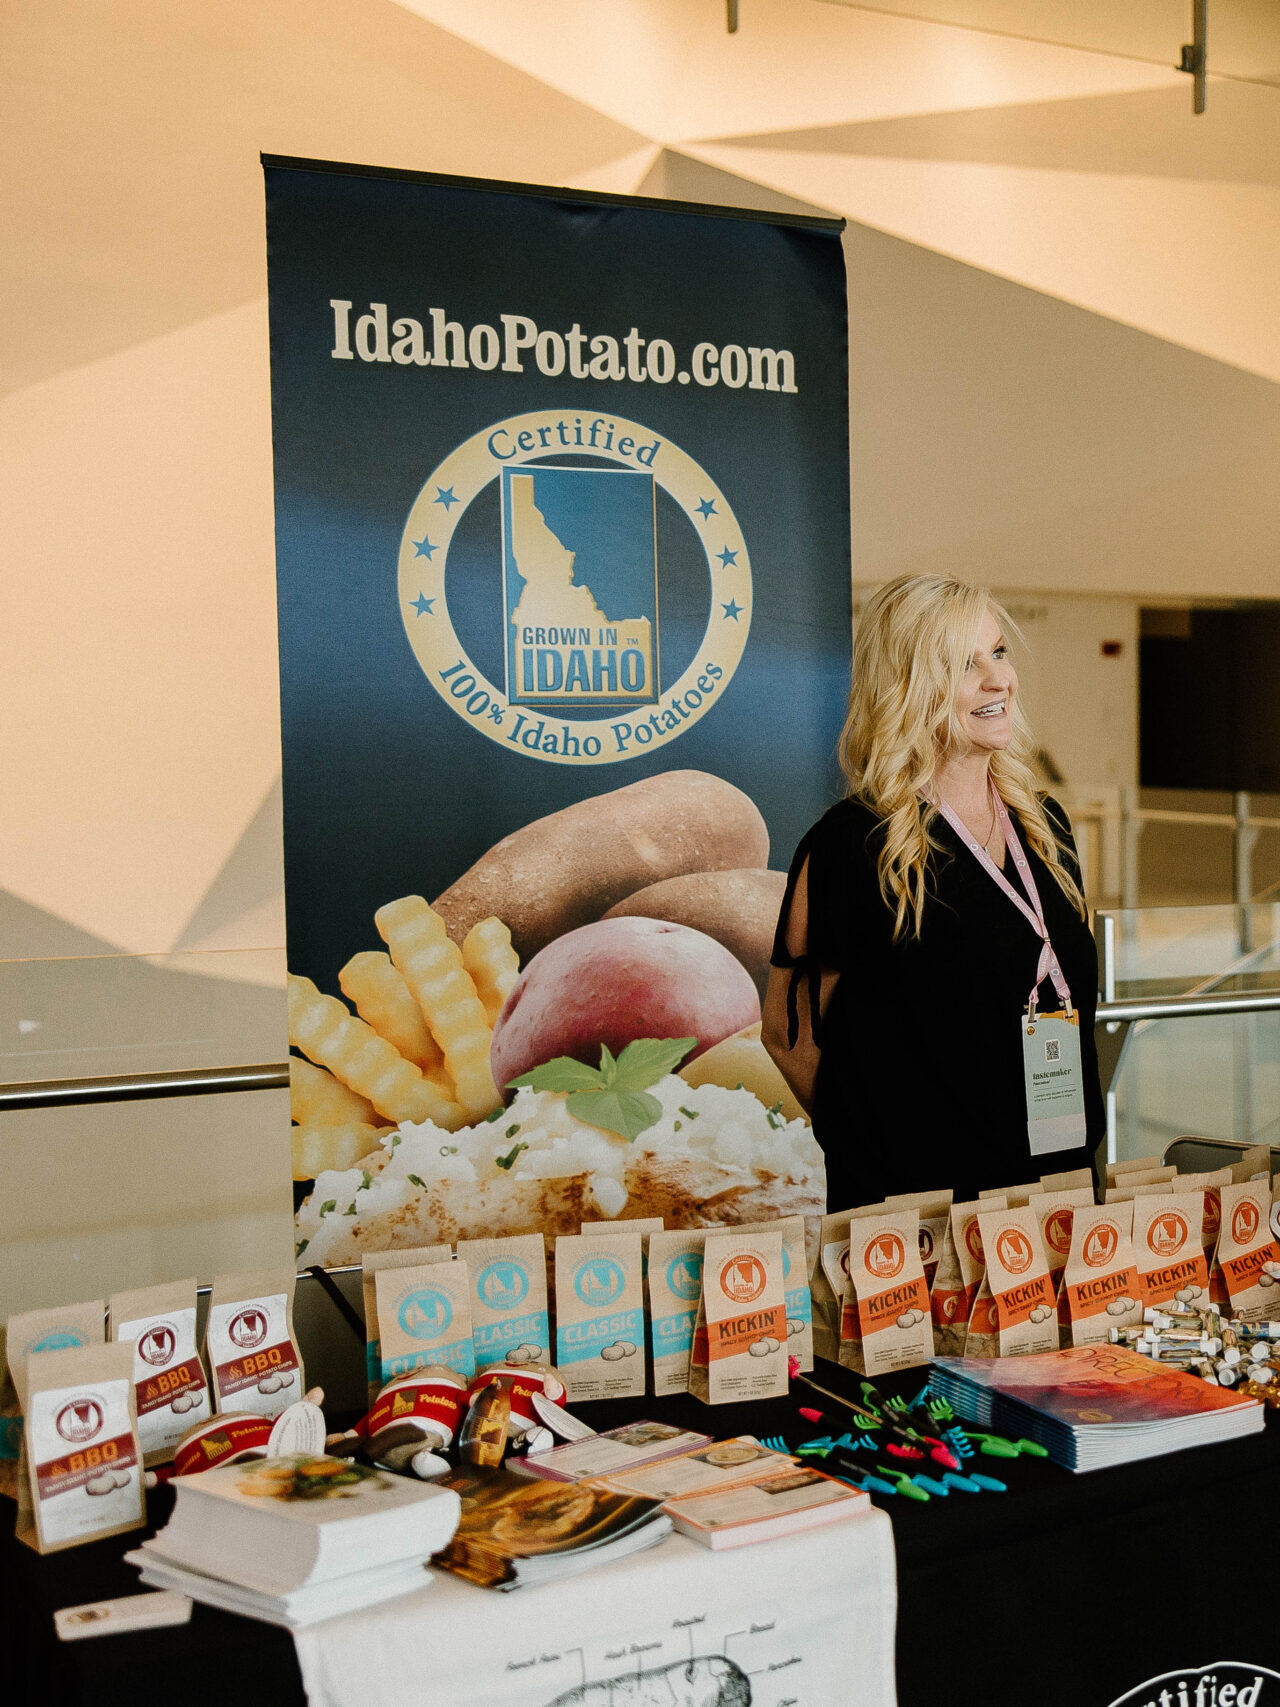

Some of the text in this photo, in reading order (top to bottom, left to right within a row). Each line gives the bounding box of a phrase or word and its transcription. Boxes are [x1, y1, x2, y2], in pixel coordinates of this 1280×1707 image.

[330, 299, 798, 393] IdahoPotato.com
[487, 417, 662, 468] Certified
[522, 627, 591, 647] GROWN
[599, 627, 617, 647] IN
[521, 648, 646, 693] IDAHO
[438, 658, 724, 757] 100% Idaho Potatoes
[1033, 1068, 1072, 1080] tastemaker
[1146, 1260, 1199, 1288] KICKIN'
[1229, 1246, 1273, 1276] KICKIN'
[868, 1282, 920, 1315] KICKIN'
[1002, 1278, 1046, 1309] KICKIN'
[1076, 1271, 1130, 1301] KICKIN'
[565, 1312, 636, 1344] CLASSIC
[719, 1310, 778, 1339] KICKIN'
[243, 1348, 282, 1375] BBQ
[156, 1366, 191, 1393] BBQ
[69, 1441, 119, 1472] BBQ
[1142, 1675, 1264, 1707] tified
